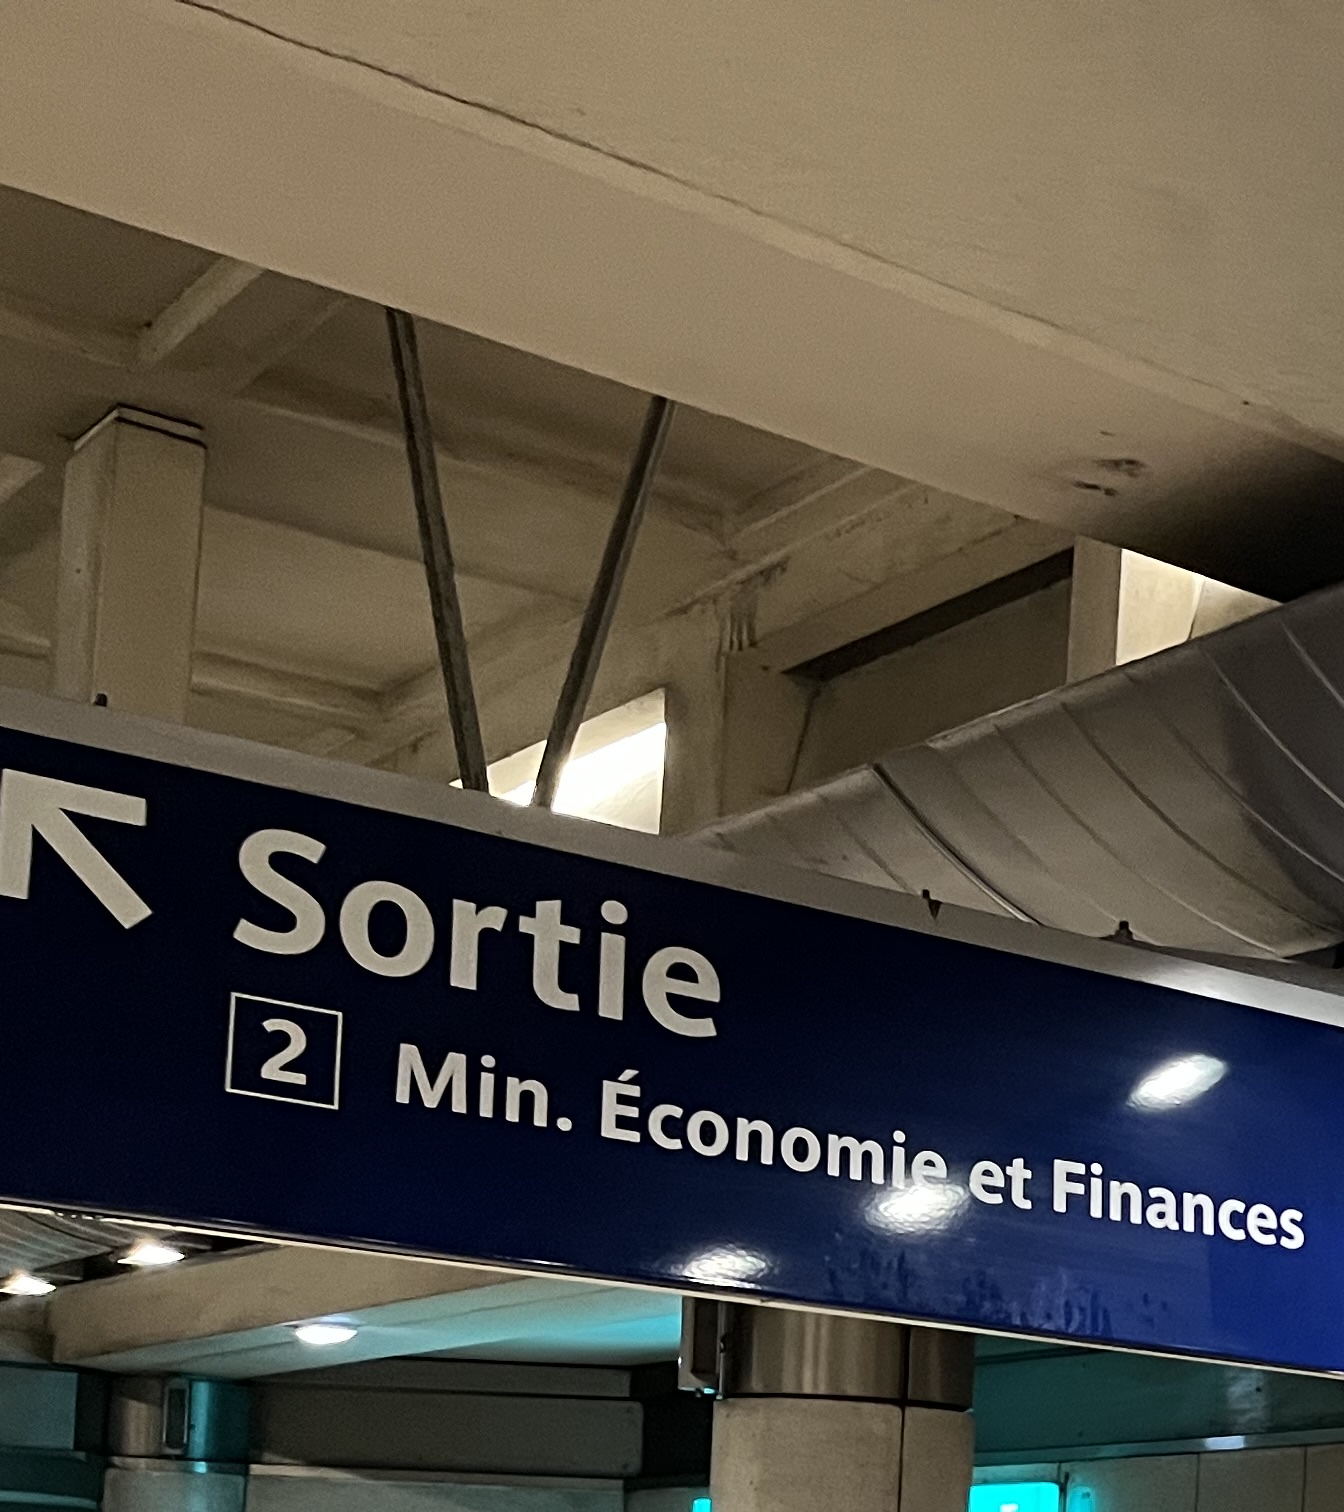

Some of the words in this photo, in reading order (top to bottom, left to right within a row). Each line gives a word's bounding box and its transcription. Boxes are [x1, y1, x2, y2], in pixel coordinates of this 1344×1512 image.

[232, 828, 722, 1038] Sortie
[260, 1018, 308, 1086] 2
[396, 1043, 573, 1132] Min.
[600, 1069, 948, 1191] Économie
[969, 1156, 1033, 1210] et
[1052, 1159, 1306, 1249] Finances
